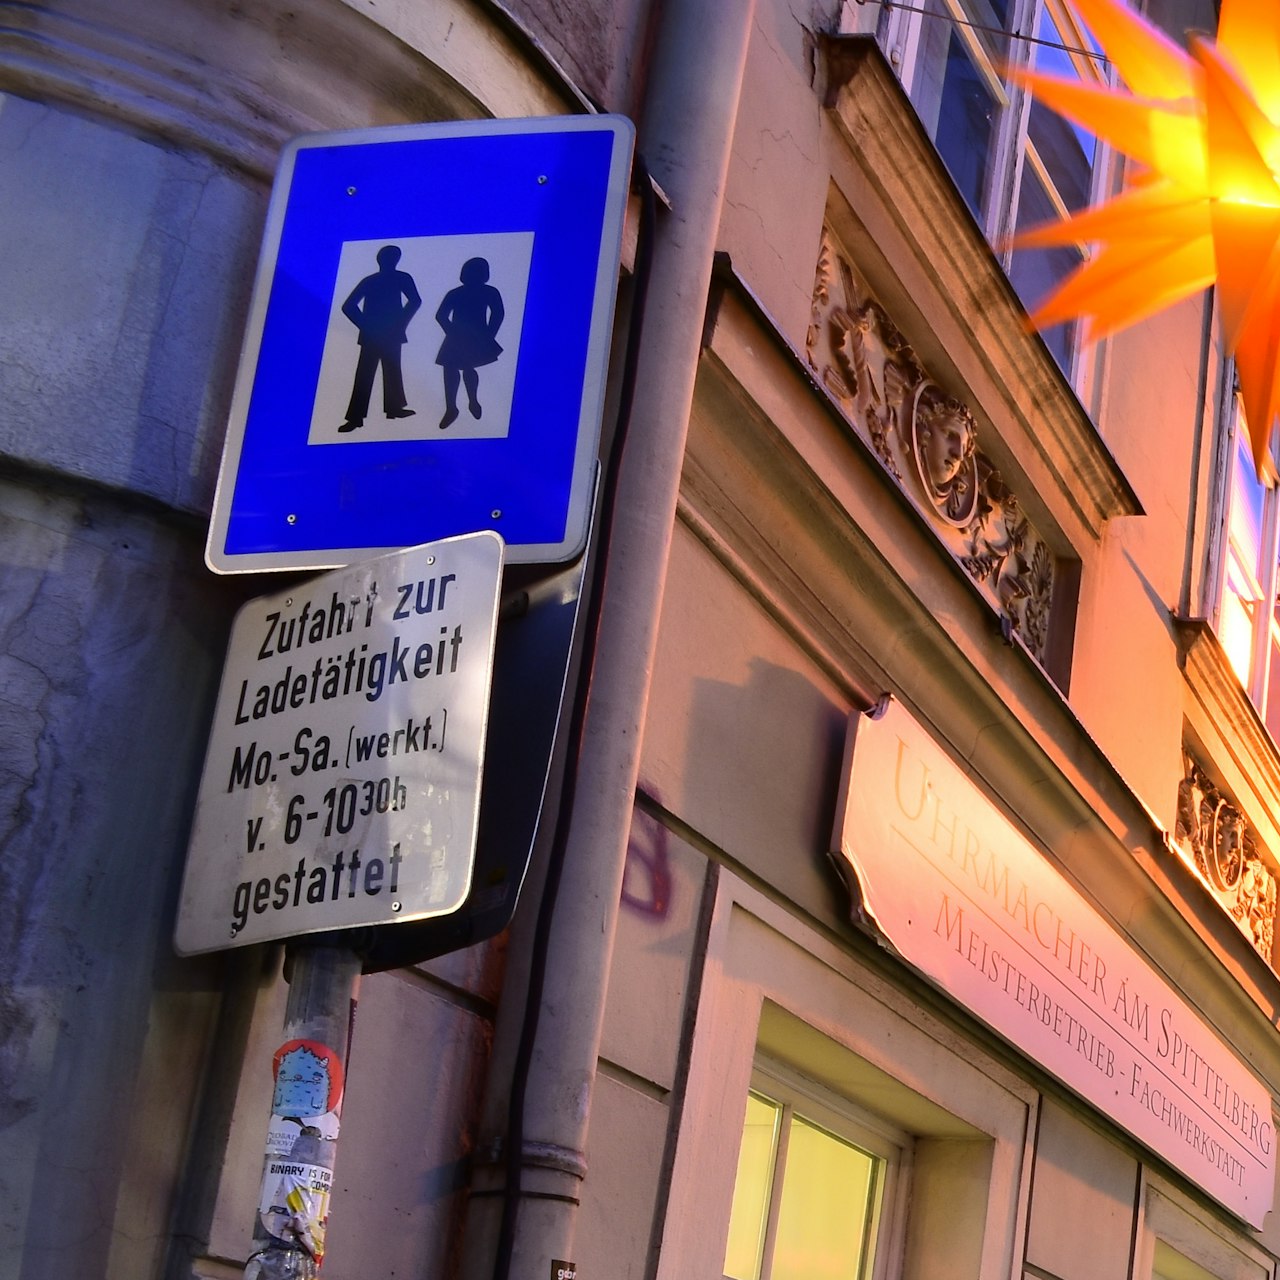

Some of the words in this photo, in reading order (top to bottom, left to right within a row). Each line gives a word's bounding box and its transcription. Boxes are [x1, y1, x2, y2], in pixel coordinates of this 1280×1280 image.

[257, 581, 378, 661] Zufahrt
[392, 573, 456, 621] zur
[234, 624, 463, 726] Ladetätigkeit
[227, 727, 339, 793] Mo.-Sa.
[246, 815, 265, 853] v.
[232, 843, 403, 933] gestattet
[893, 733, 1108, 1006] UHRMACHER
[1113, 979, 1151, 1043] AM
[1154, 1007, 1272, 1156] SPITTELBERG
[933, 891, 1115, 1079] MEISTERBETRIEB
[1128, 1062, 1246, 1188] FACHWERKSTATT
[270, 1164, 304, 1177] BINARY
[308, 1168, 317, 1179] IS
